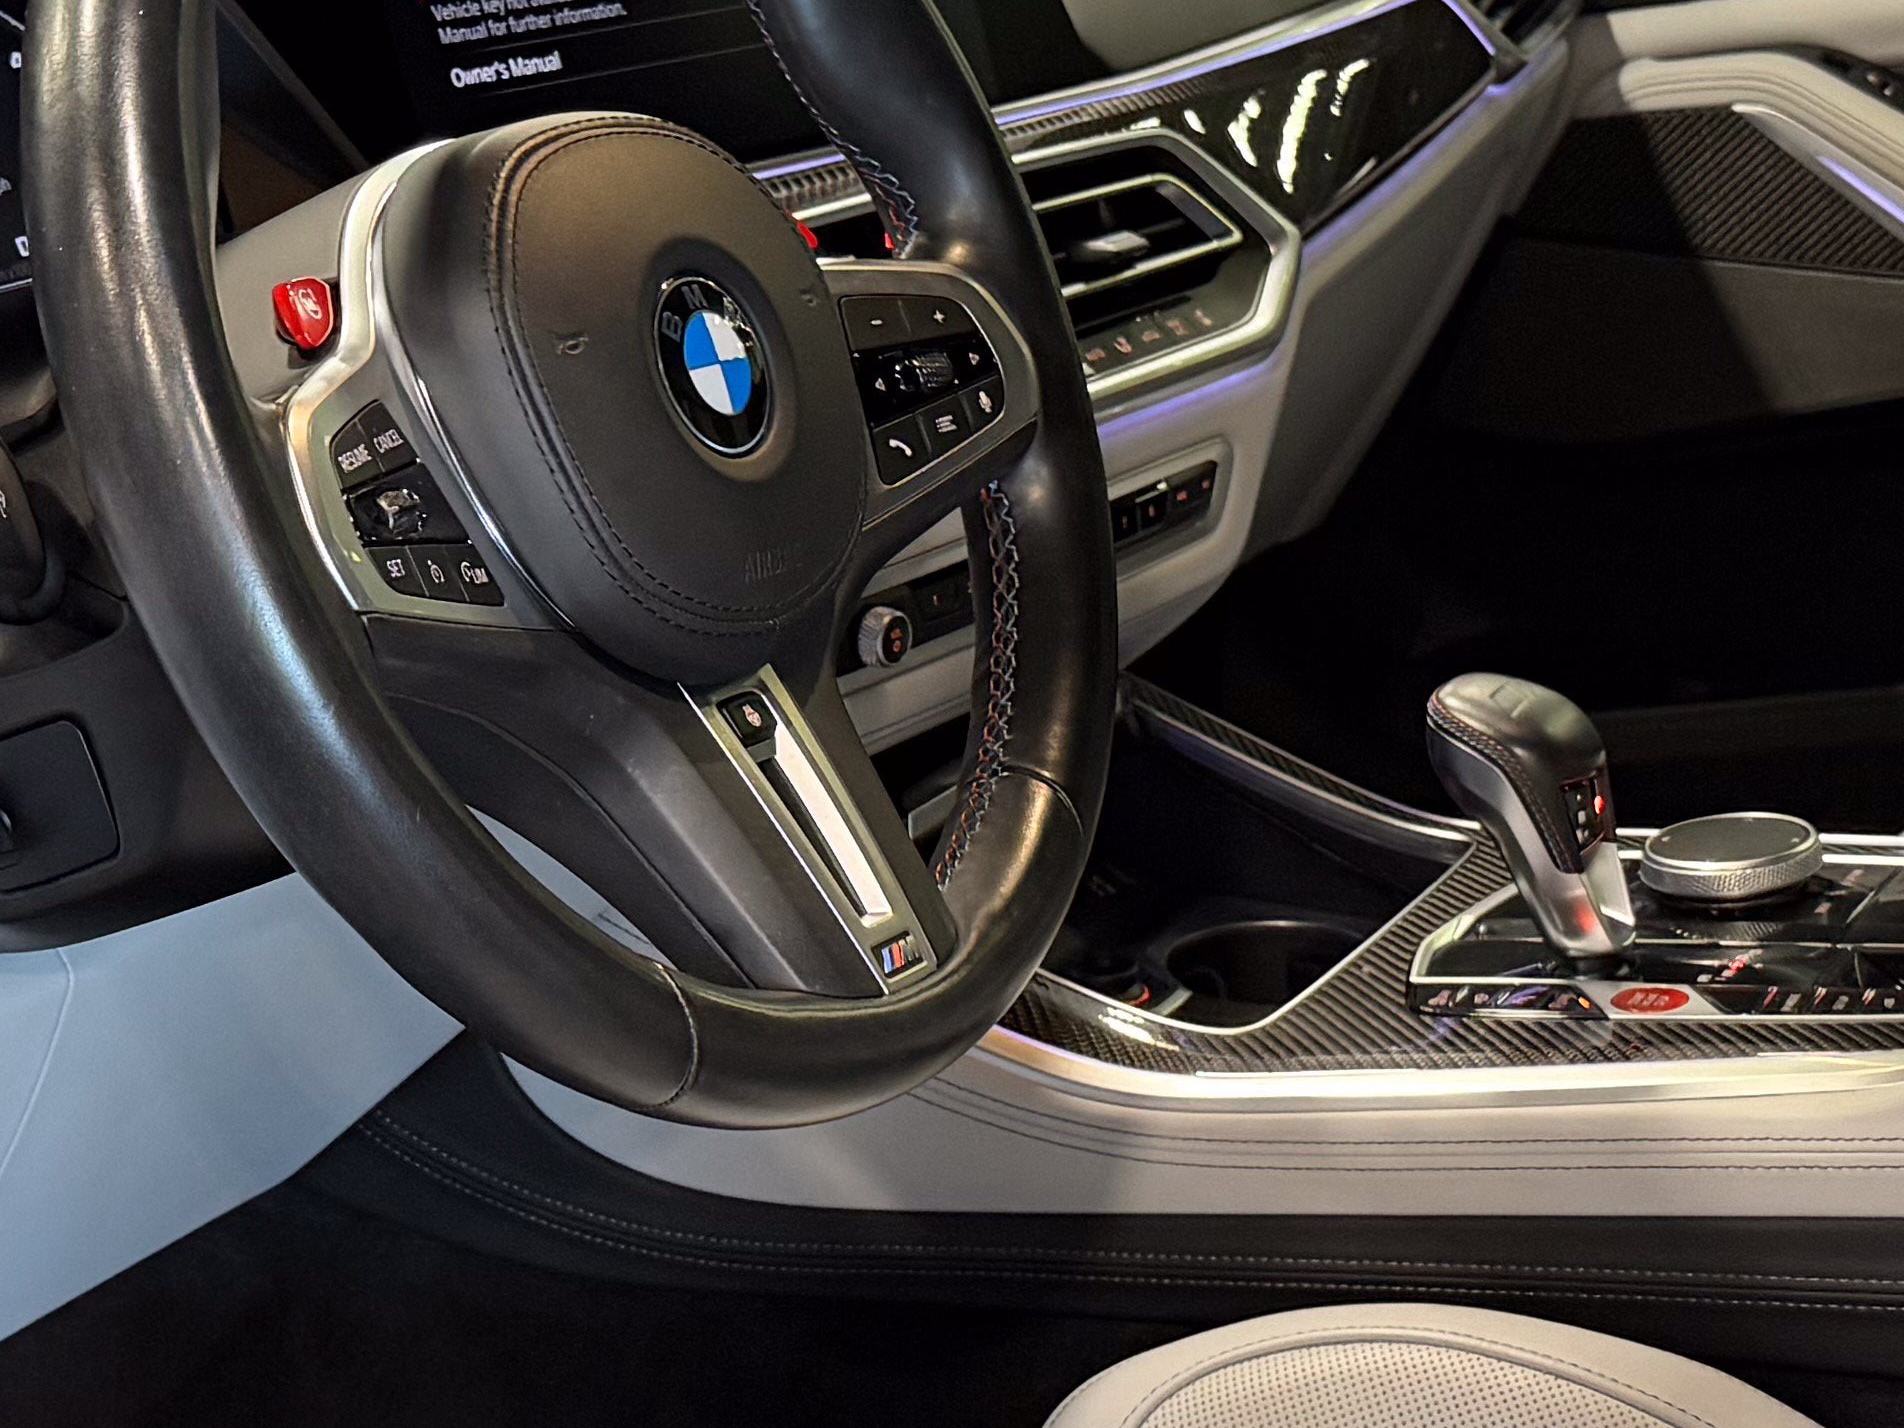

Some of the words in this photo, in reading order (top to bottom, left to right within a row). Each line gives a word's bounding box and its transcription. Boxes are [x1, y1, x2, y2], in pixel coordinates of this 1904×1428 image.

[431, 0, 481, 21] Vehicle
[438, 18, 488, 44] Manual
[487, 17, 508, 38] for
[507, 12, 552, 34] further
[553, 0, 628, 27] information.
[450, 58, 510, 88] Owner's
[507, 50, 563, 78] Manual
[386, 558, 406, 578] SET
